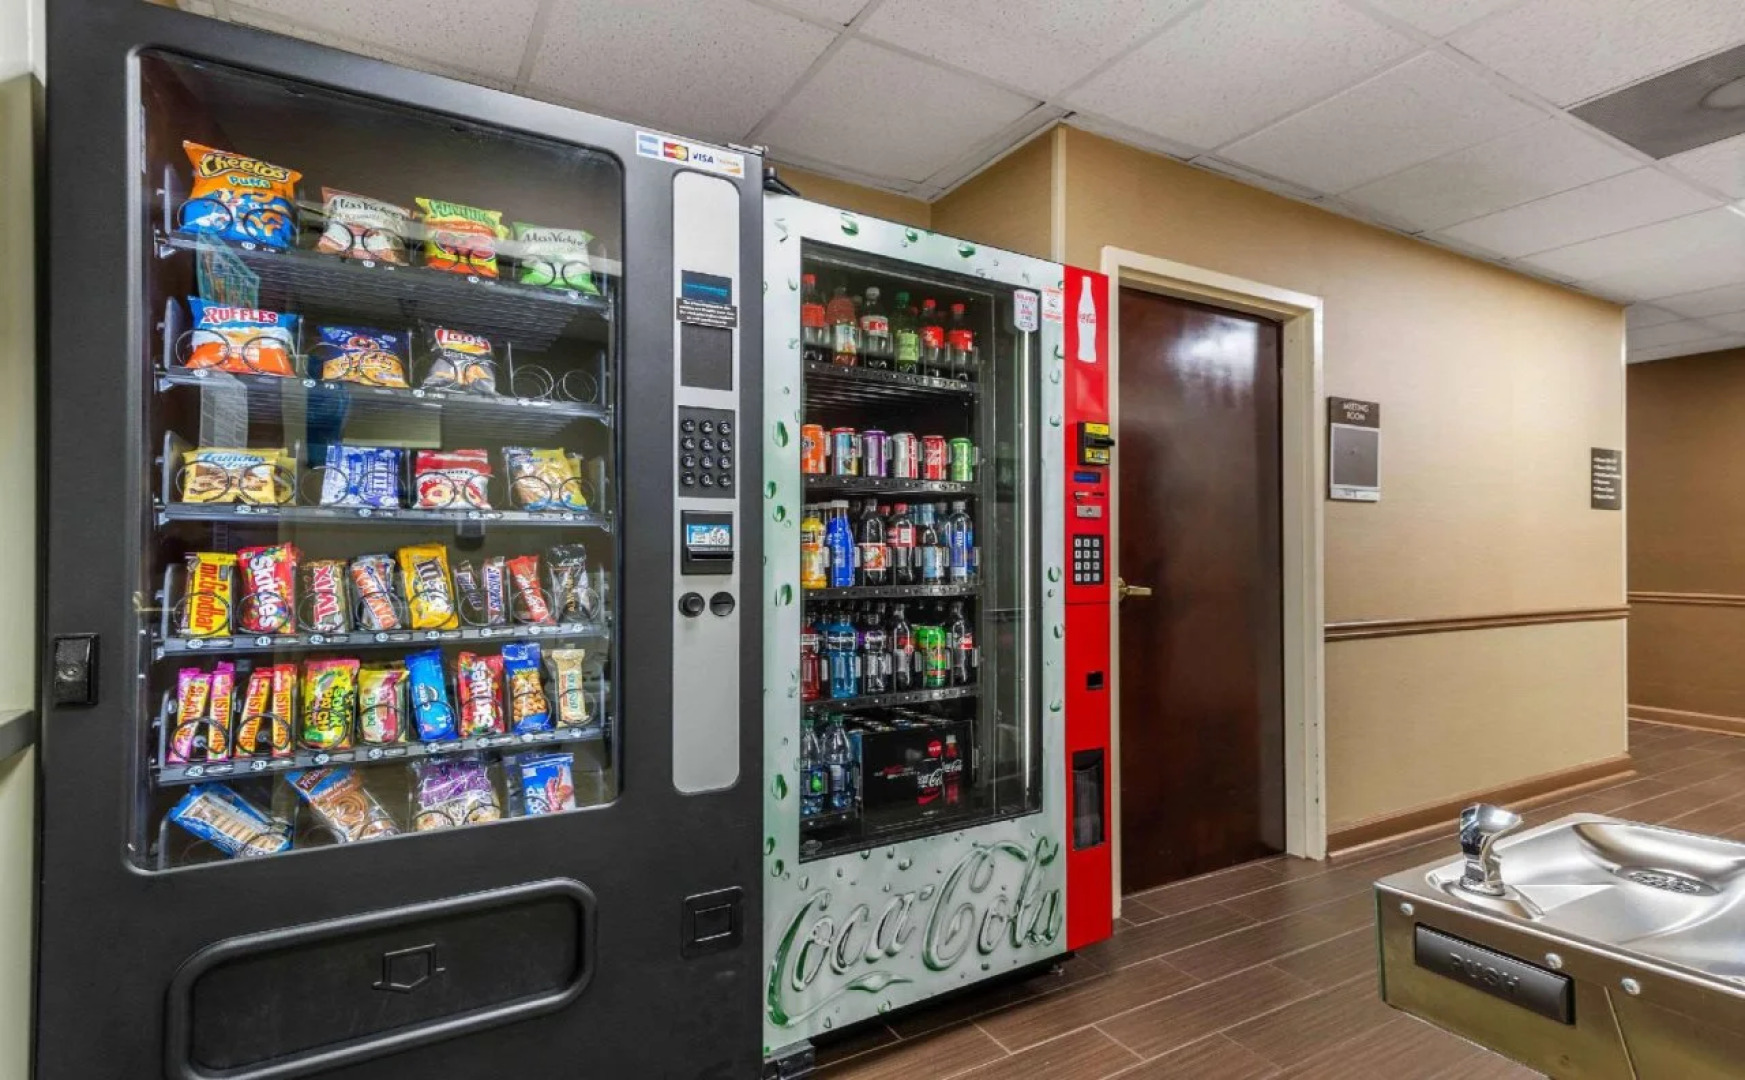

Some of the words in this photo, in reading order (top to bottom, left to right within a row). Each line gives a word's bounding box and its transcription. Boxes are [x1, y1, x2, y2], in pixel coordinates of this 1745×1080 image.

[200, 155, 288, 180] Cheetos
[693, 153, 714, 164] VISA
[203, 306, 279, 324] RUFFLES
[1346, 411, 1366, 421] ROOM
[250, 555, 279, 628] Skittles
[470, 660, 494, 727] Skittles
[1450, 952, 1520, 991] PUSH
